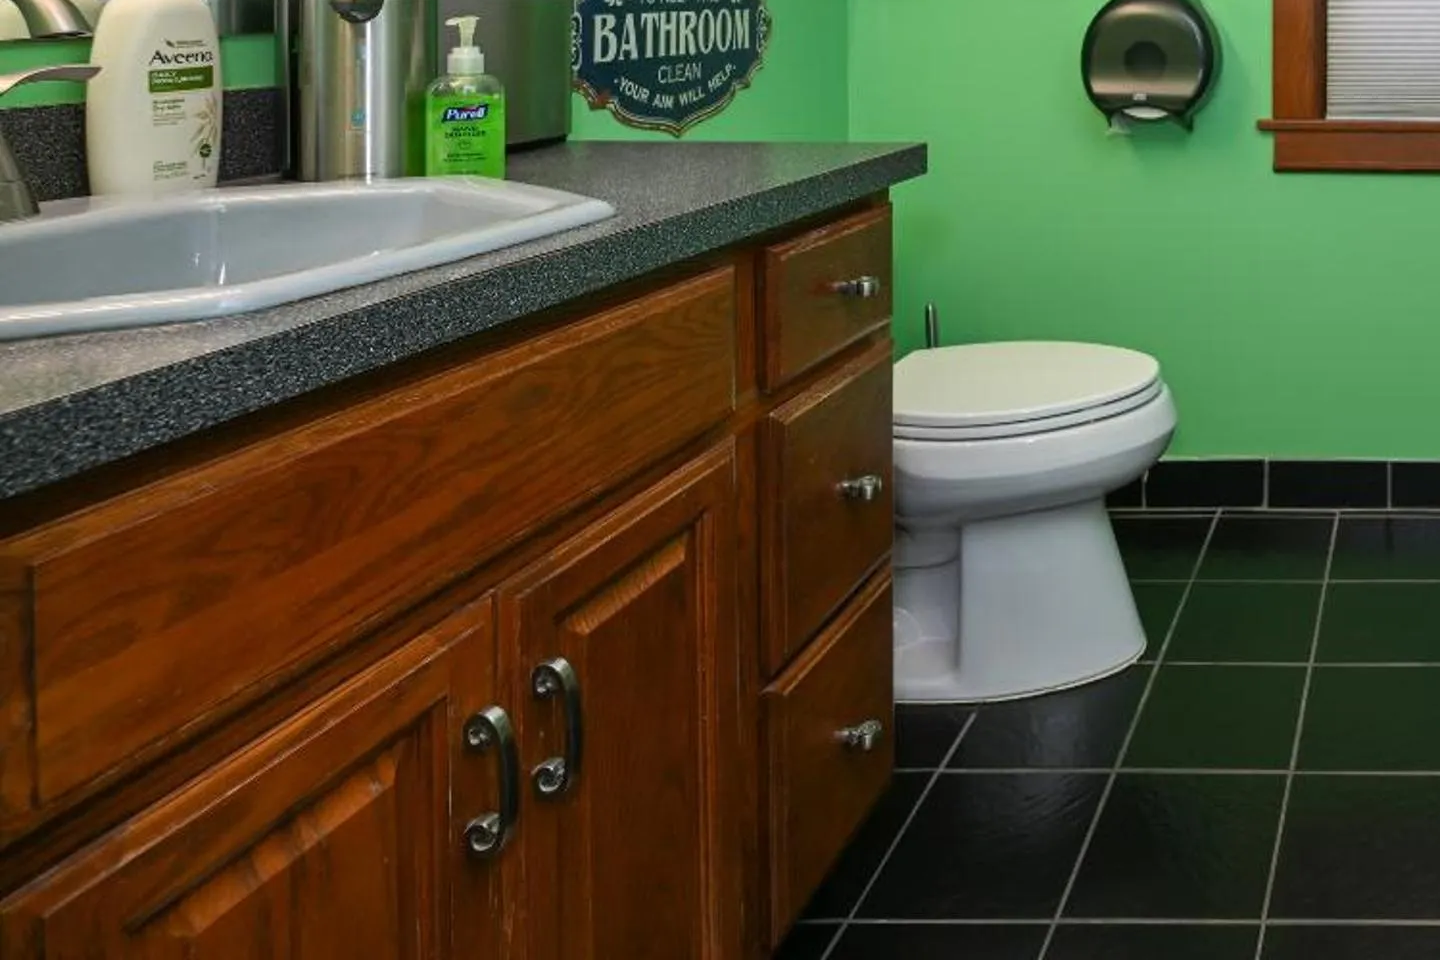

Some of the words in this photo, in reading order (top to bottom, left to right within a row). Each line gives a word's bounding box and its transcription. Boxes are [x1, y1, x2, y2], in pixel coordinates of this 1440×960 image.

[593, 8, 750, 63] BATHROOM
[619, 76, 650, 103] YOUR
[652, 93, 674, 110] AIM
[678, 86, 706, 107] WILL
[707, 63, 732, 92] HELP
[657, 62, 702, 84] CLEAN
